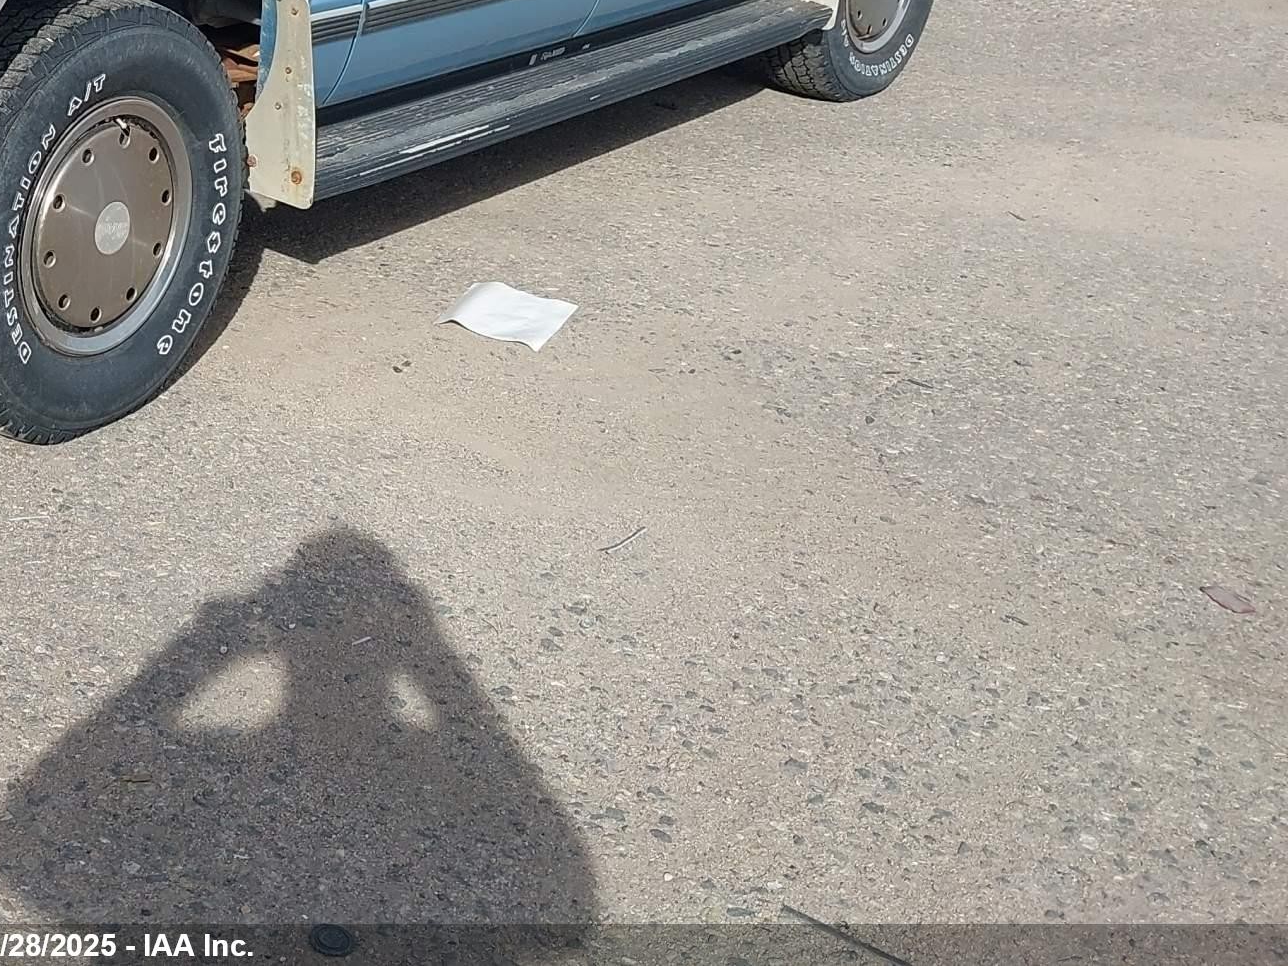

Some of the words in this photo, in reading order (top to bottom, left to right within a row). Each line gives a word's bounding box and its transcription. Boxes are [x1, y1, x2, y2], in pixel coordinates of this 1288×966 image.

[849, 33, 915, 77] DESTINATION
[2, 124, 57, 365] DESTINATION
[66, 74, 106, 117] A/T
